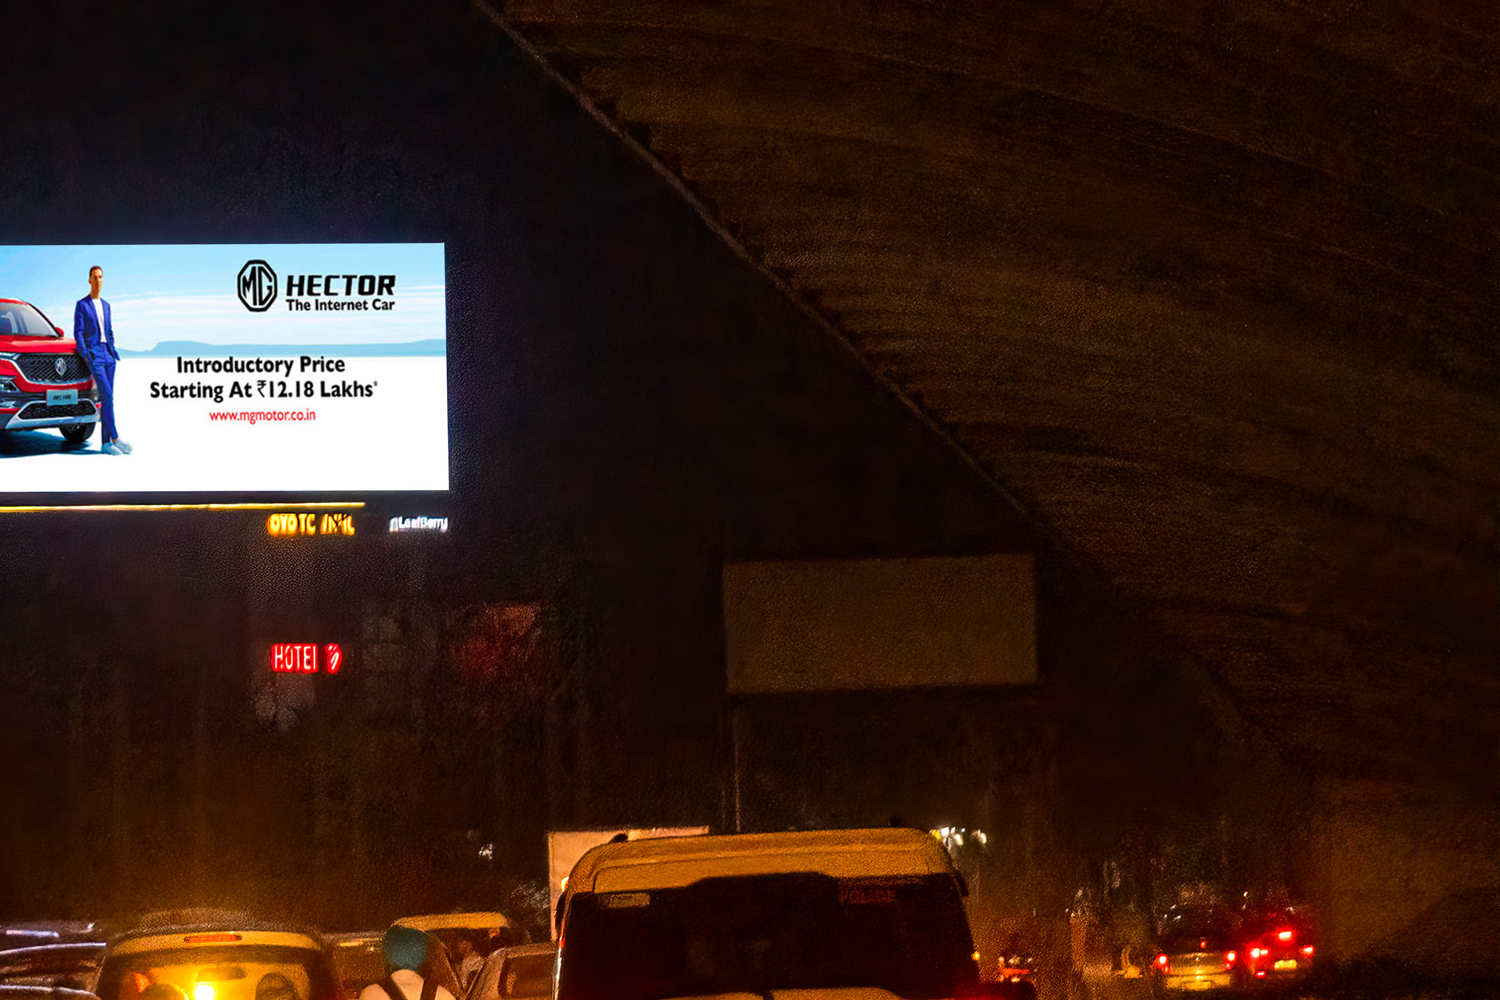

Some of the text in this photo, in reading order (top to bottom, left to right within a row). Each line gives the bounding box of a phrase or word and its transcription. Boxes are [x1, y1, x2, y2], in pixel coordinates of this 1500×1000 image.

[241, 263, 275, 309] MG
[286, 275, 396, 296] HECTOR
[286, 299, 395, 311] The Internet Car
[176, 356, 346, 377] Introductory Price
[150, 382, 224, 403] Starting
[229, 382, 253, 398] At
[209, 408, 316, 425] www.mgmotor.co.in
[267, 512, 298, 536] OYO
